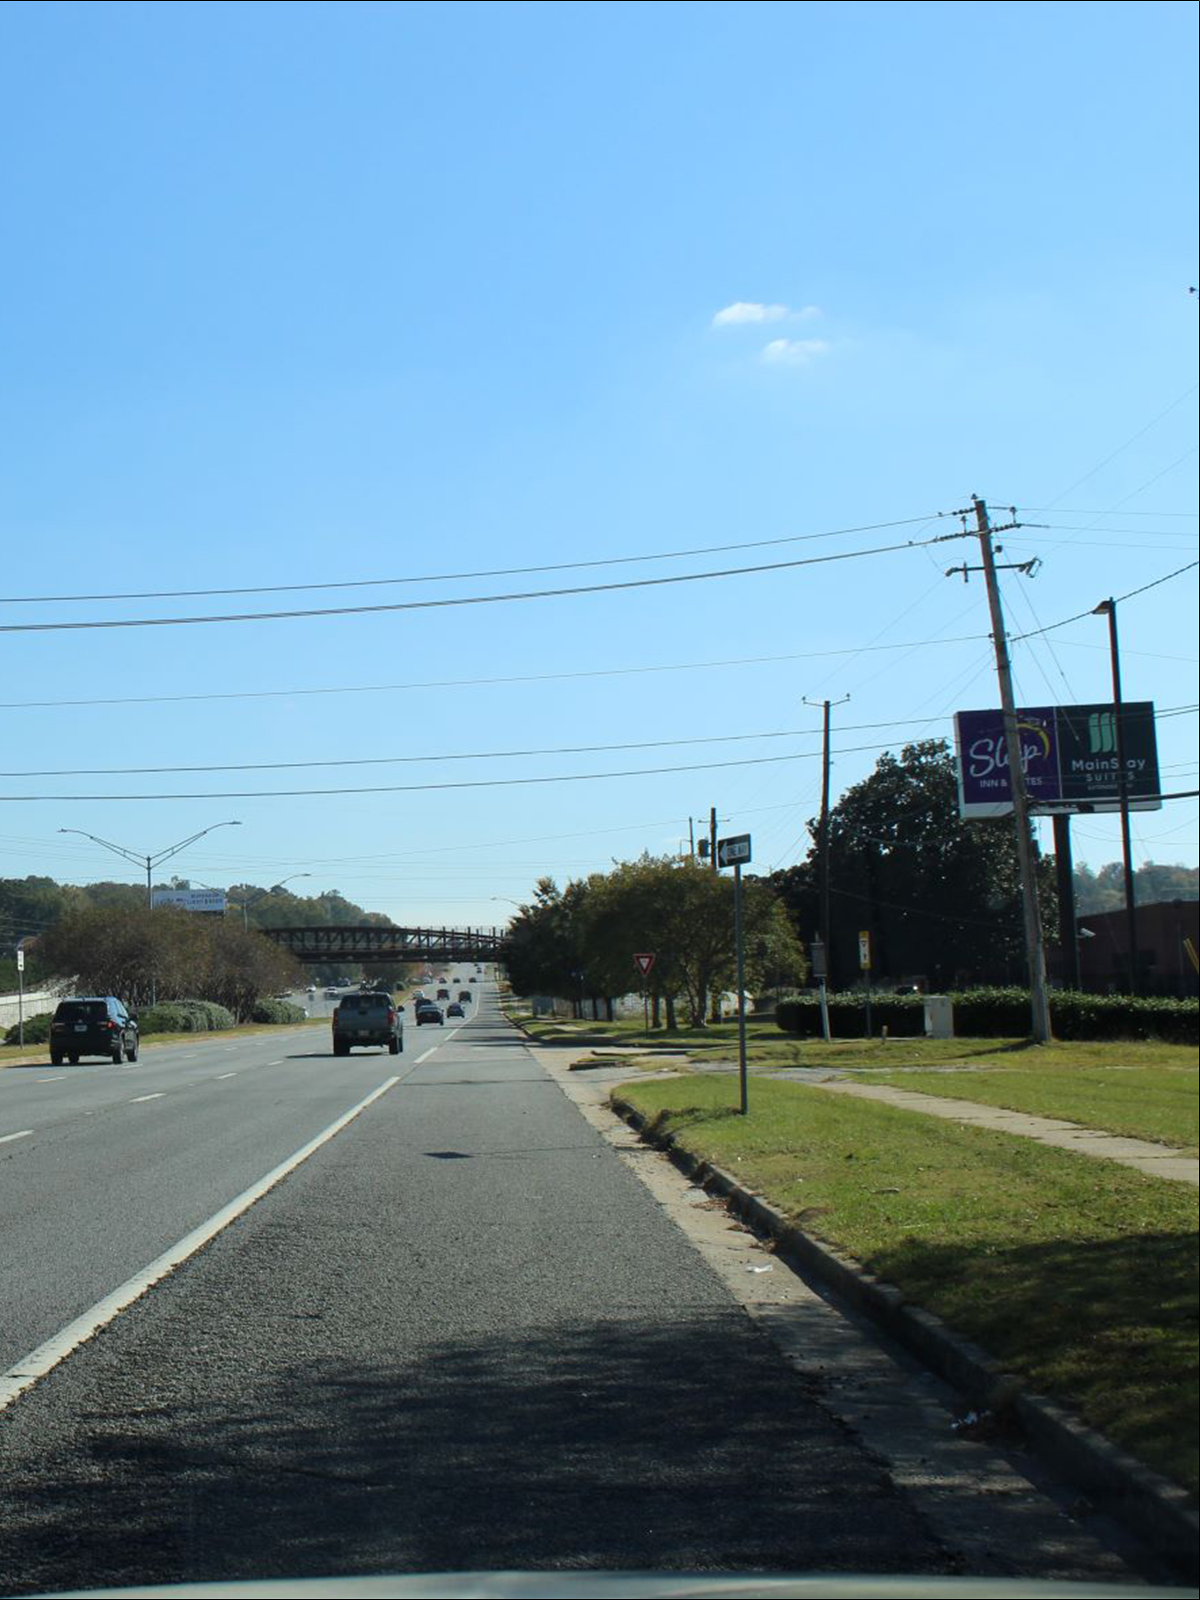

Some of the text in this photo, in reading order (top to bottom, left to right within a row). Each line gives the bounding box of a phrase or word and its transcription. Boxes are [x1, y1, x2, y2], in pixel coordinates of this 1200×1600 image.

[969, 736, 1041, 778] Slp
[1071, 757, 1146, 771] MainSay
[1085, 771, 1135, 782] SUITS
[980, 779, 999, 788] INN
